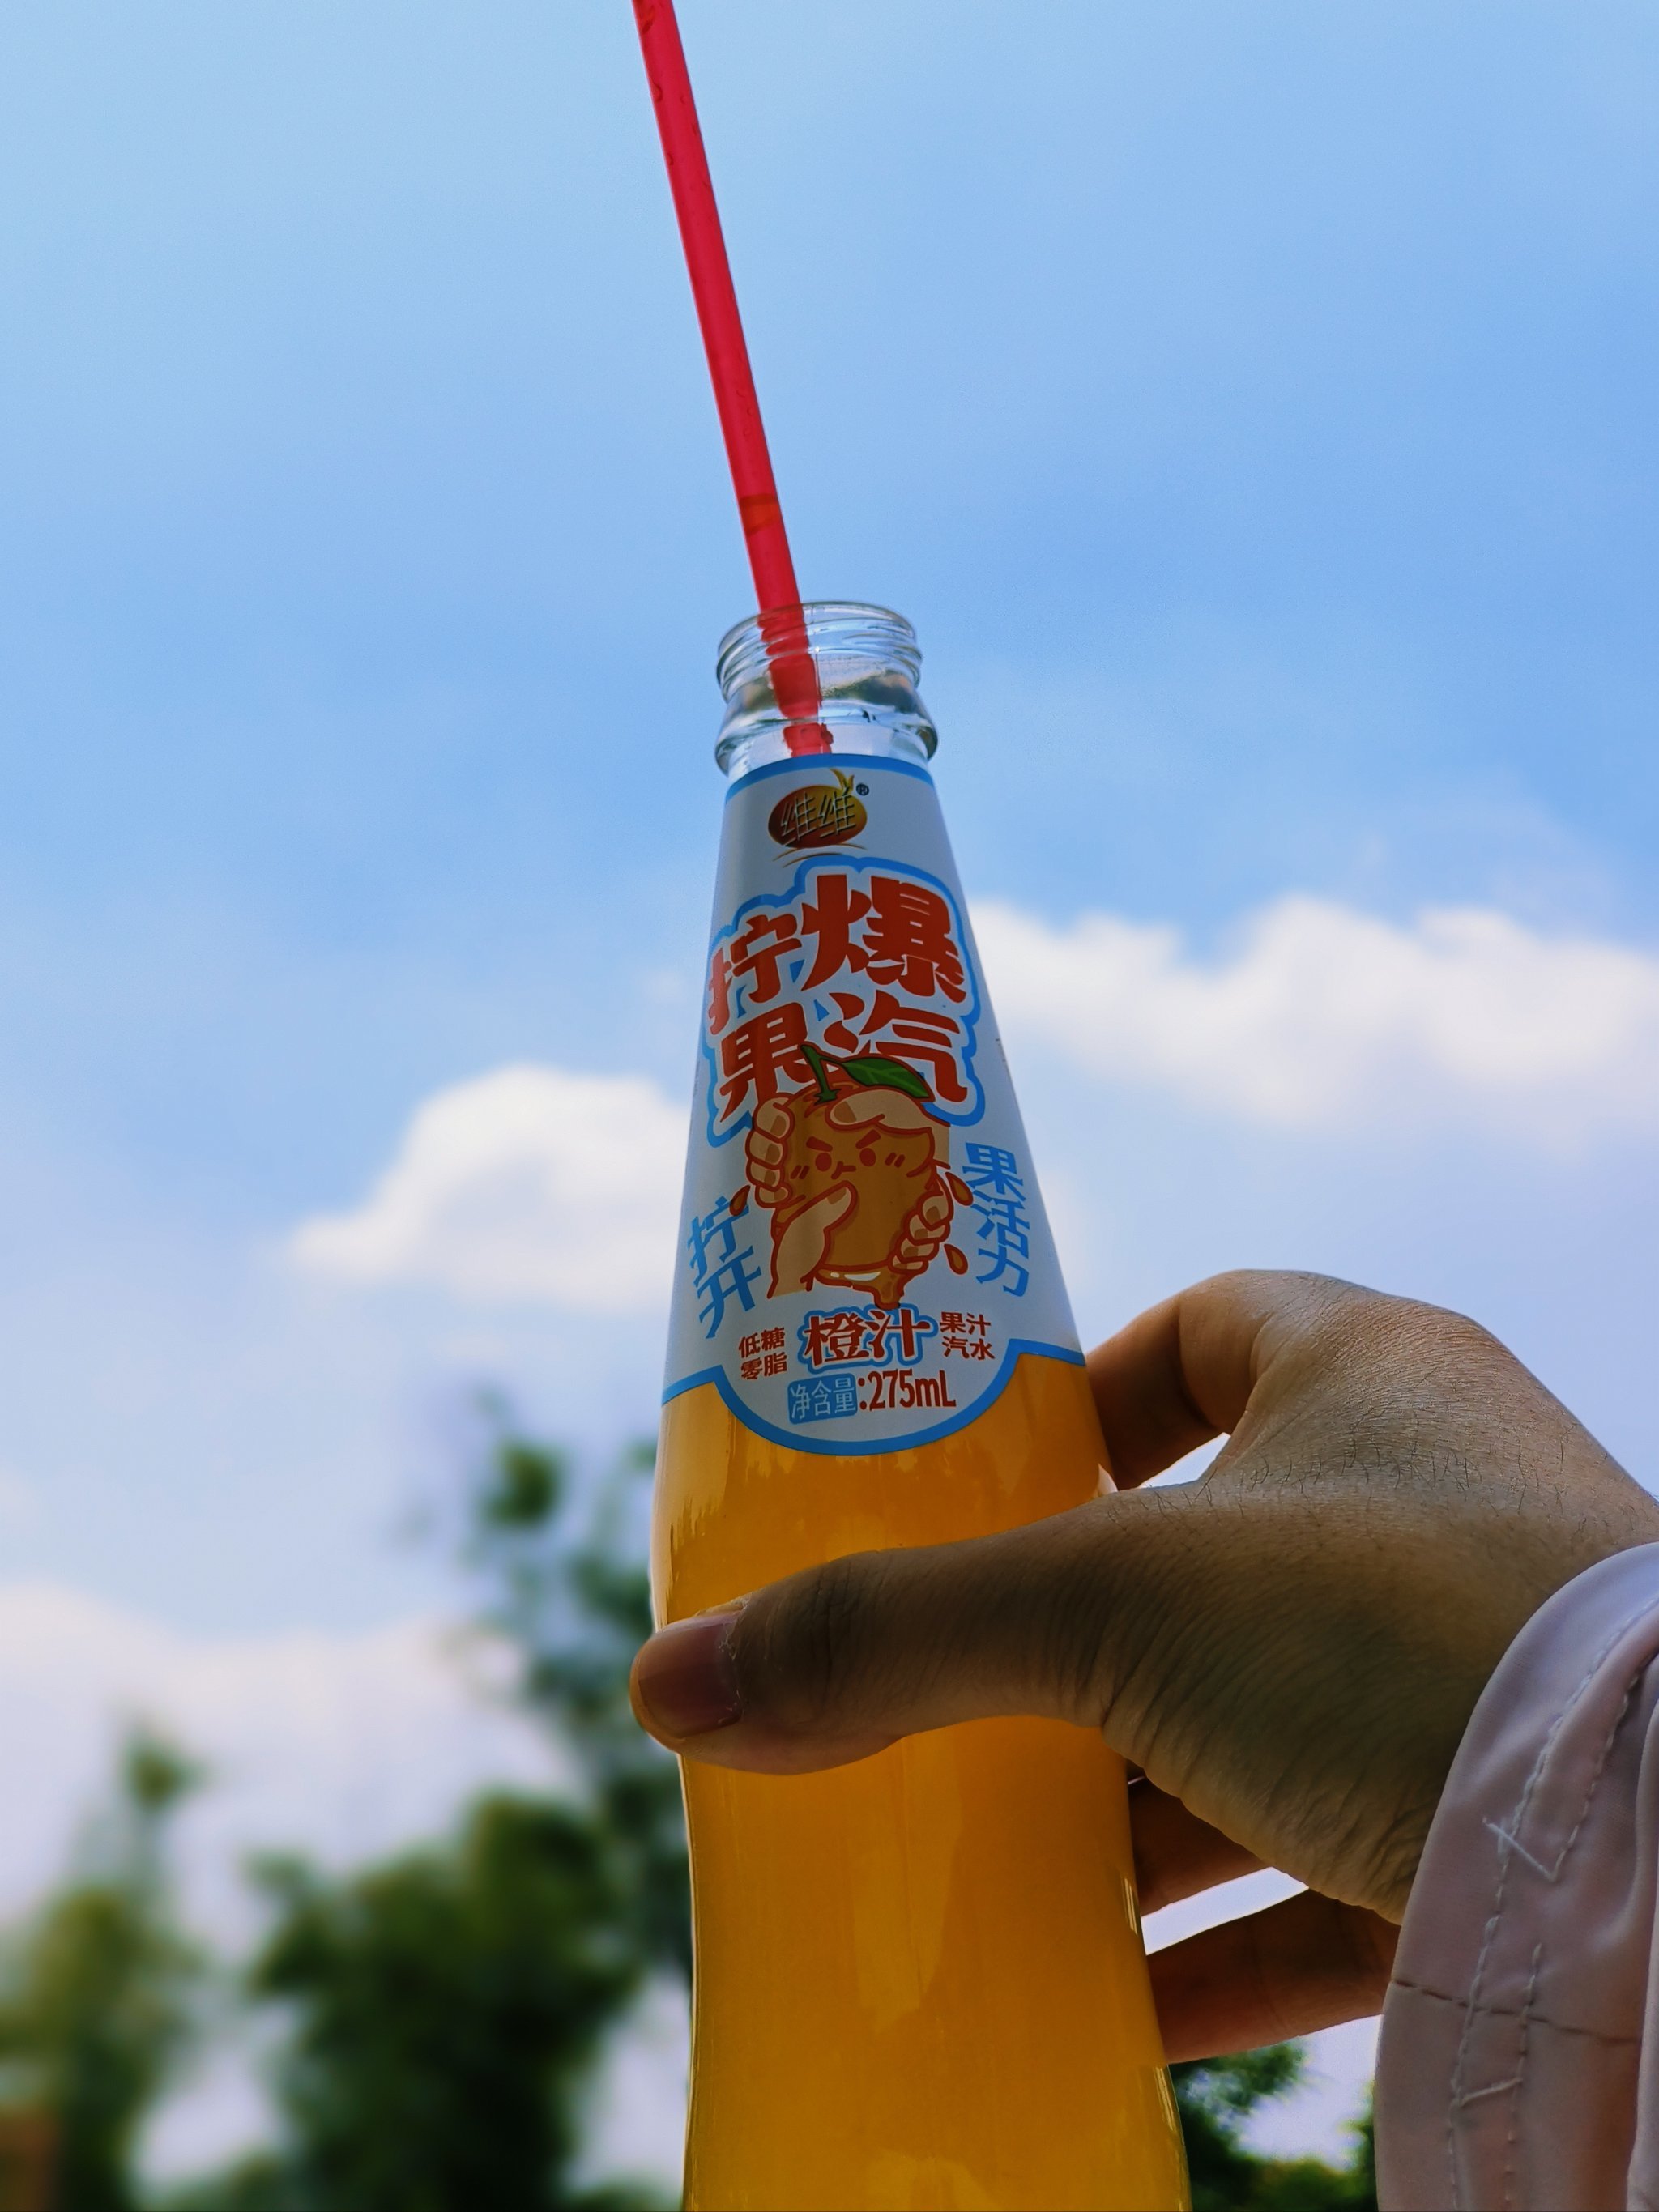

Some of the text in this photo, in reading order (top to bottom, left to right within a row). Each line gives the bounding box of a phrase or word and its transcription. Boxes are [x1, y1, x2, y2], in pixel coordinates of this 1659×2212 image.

[708, 874, 966, 1035] 拧爆
[720, 989, 967, 1123] 果汽
[962, 1142, 1030, 1297] 果活力
[687, 1196, 761, 1339] 拧开
[738, 1327, 786, 1358] 低糖
[804, 1308, 931, 1366] 橙汁
[940, 1311, 992, 1336] 果汁
[941, 1336, 996, 1361] 汽水
[740, 1353, 787, 1380] 零脂
